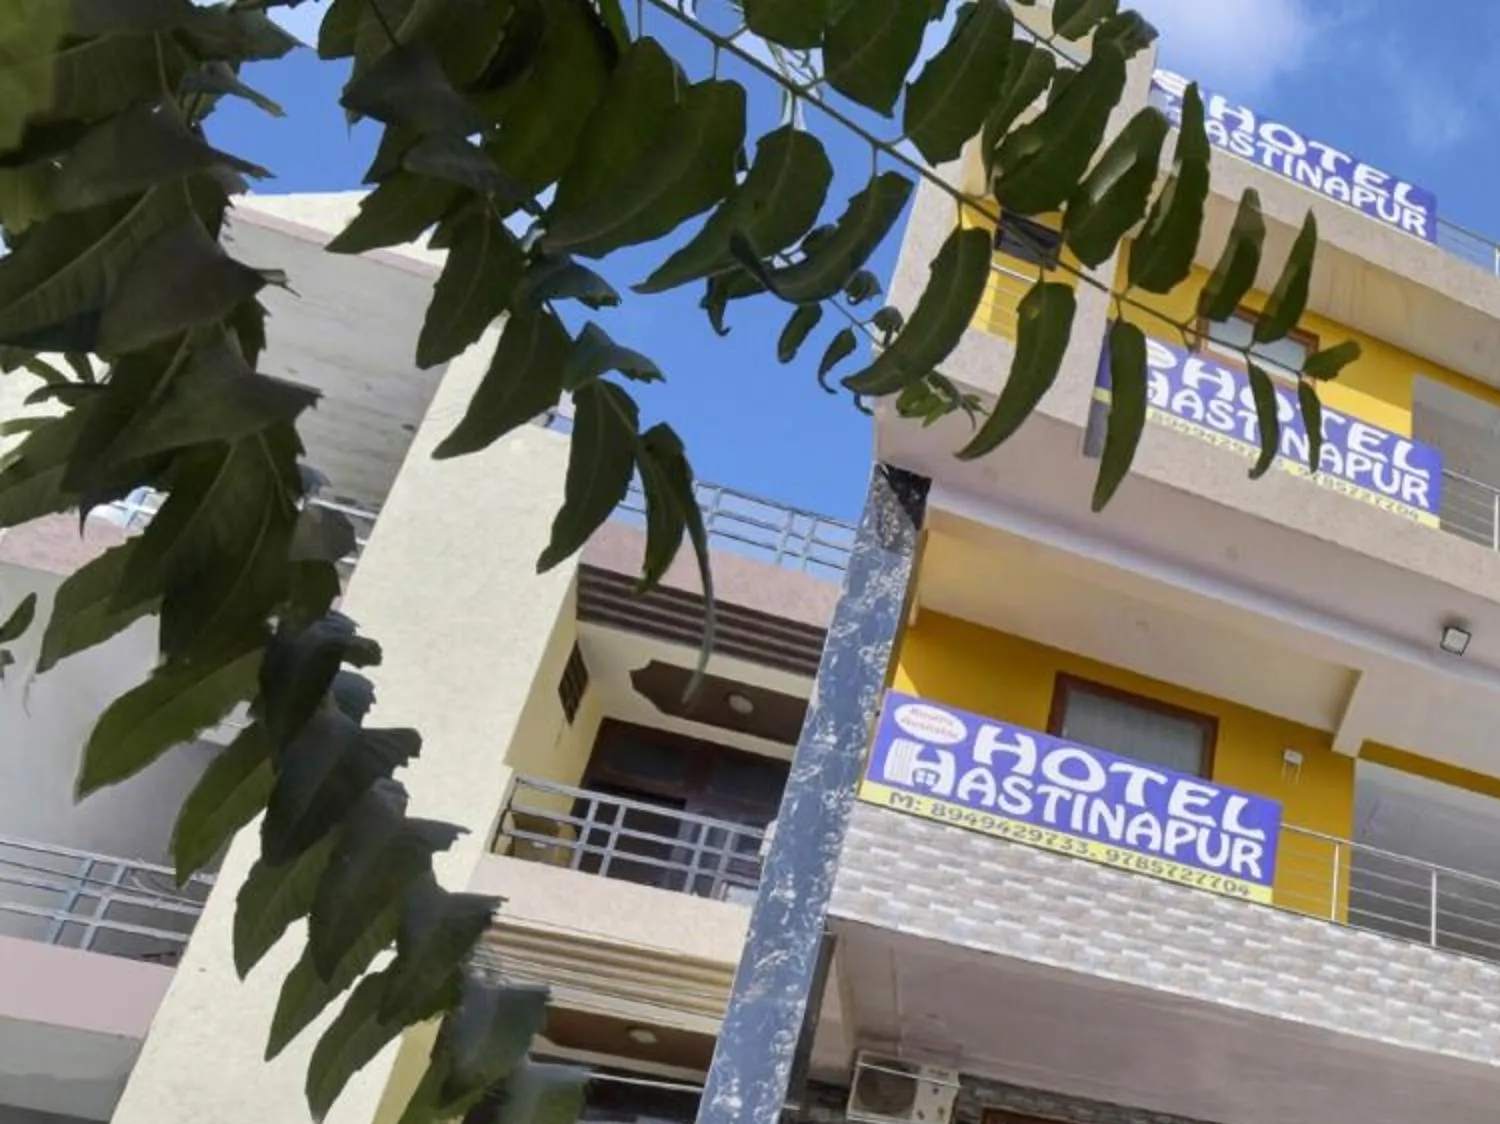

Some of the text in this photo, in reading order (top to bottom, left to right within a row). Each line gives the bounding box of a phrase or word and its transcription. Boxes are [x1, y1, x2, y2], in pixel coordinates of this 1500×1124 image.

[1205, 119, 1428, 237] ASTINAPUR
[1209, 94, 1428, 214] HOTEL
[884, 737, 1263, 879] HASTINAPUR
[889, 790, 921, 816] M:
[973, 724, 1266, 841] HOTEL
